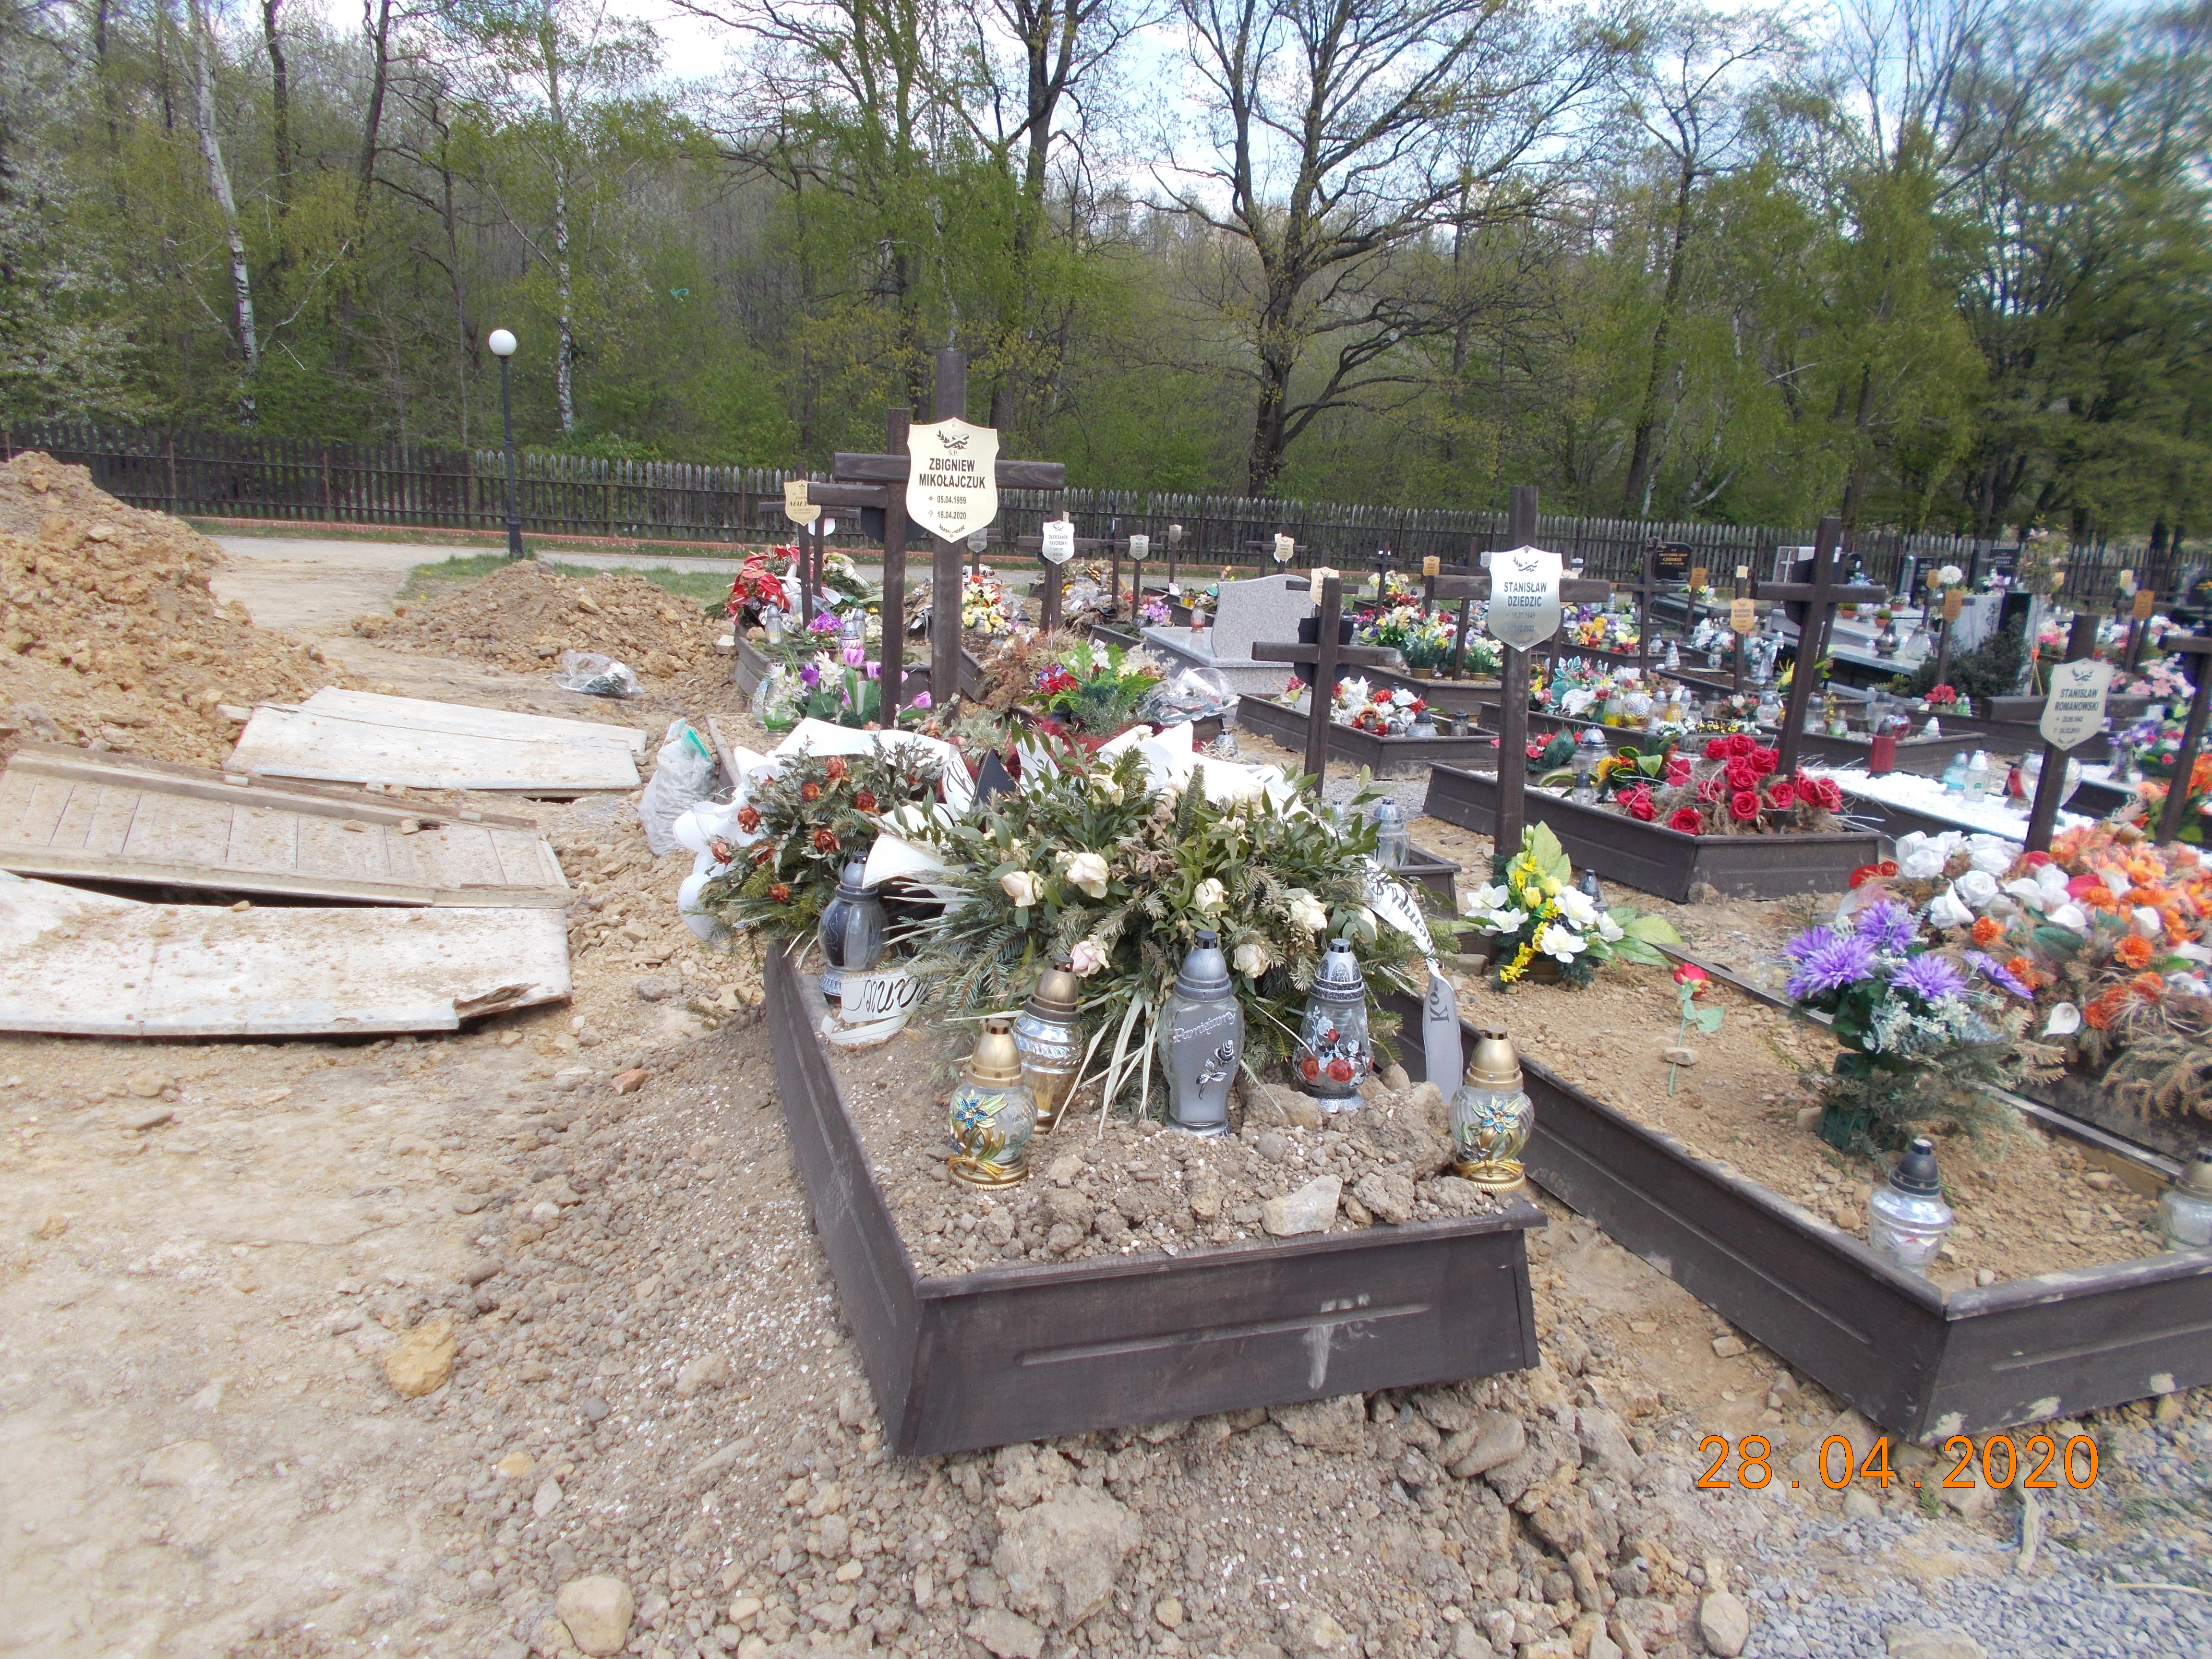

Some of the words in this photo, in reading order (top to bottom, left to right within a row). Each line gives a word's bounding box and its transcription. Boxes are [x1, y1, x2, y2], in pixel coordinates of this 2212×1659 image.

[929, 458, 975, 472] ZBIGNIEW
[919, 473, 986, 489] MIKOŁAJCZUK
[937, 495, 966, 504] 05.04.1959
[938, 511, 966, 519] 18.04.2020
[1504, 582, 1547, 592] STANISŁAW
[1508, 596, 1542, 607] DZIEDZIC
[2055, 701, 2100, 711] ROMANOWSKI
